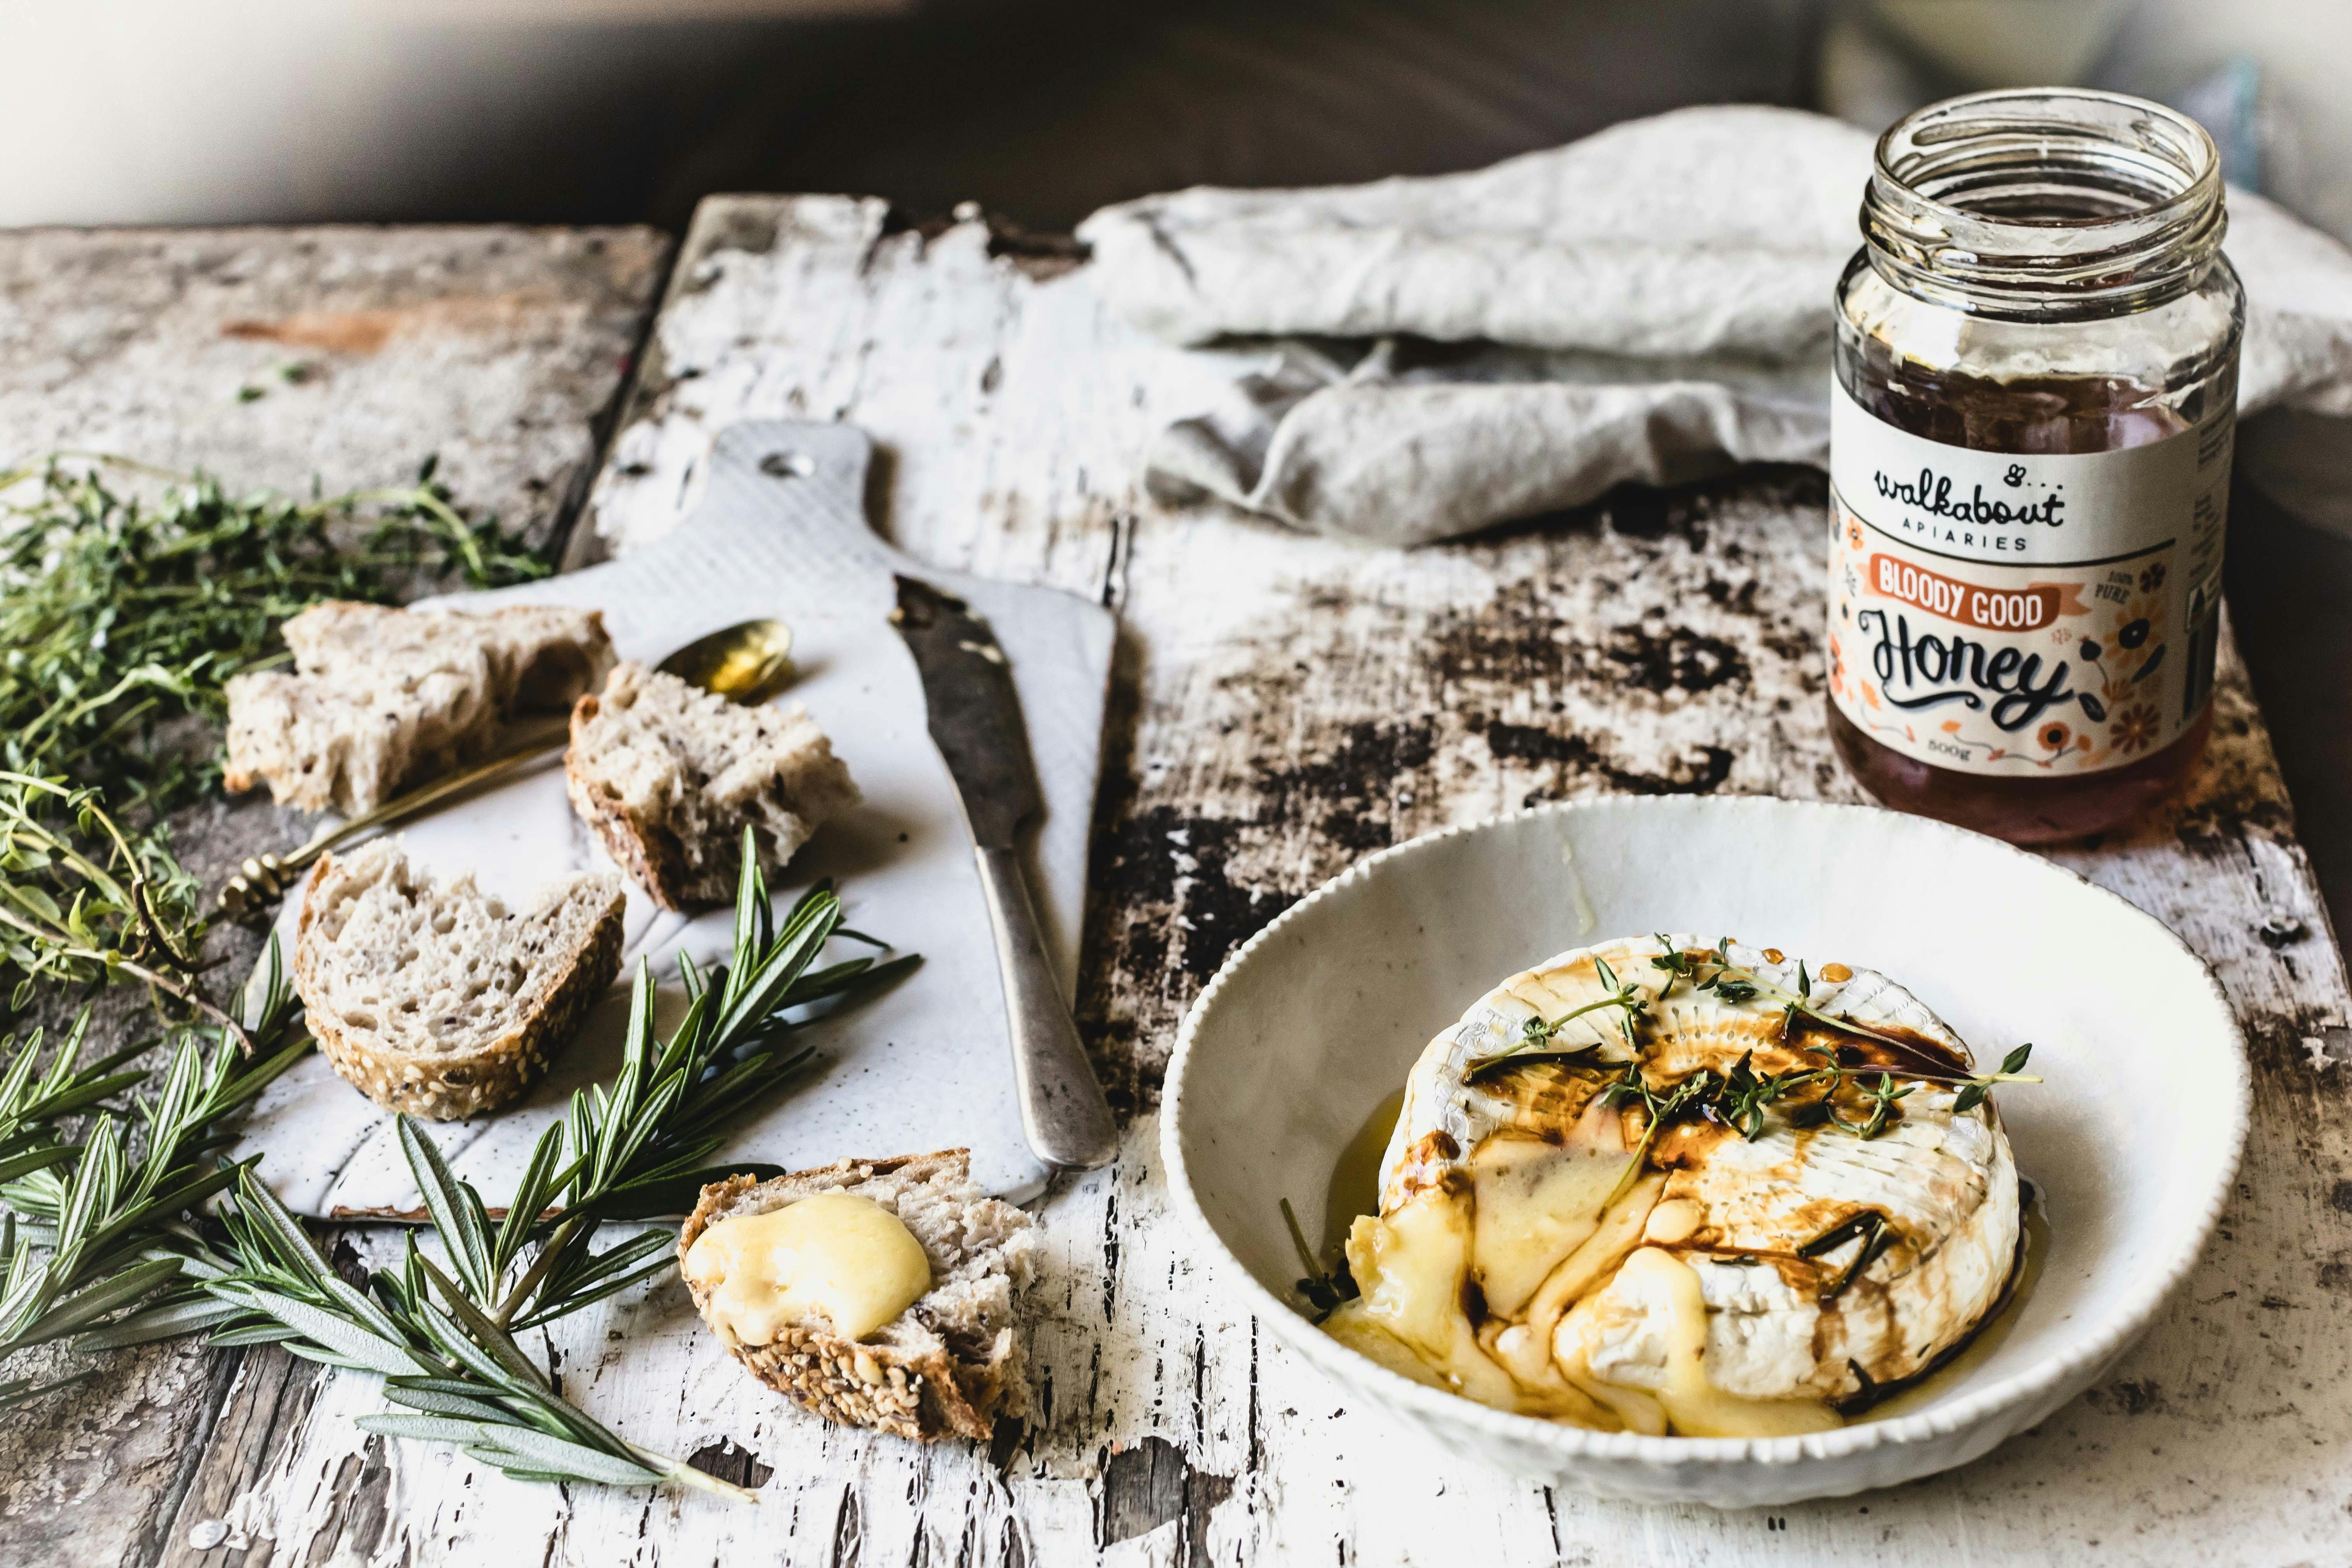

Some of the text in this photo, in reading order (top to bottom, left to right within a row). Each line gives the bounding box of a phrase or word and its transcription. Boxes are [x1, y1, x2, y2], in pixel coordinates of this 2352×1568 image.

[1874, 468, 2065, 527] walkabout
[1903, 517, 2026, 551] APIARIES
[1879, 558, 2042, 628] BLOODY GOOD
[1858, 609, 2074, 732] Honey
[1928, 739, 1971, 762] 500g
